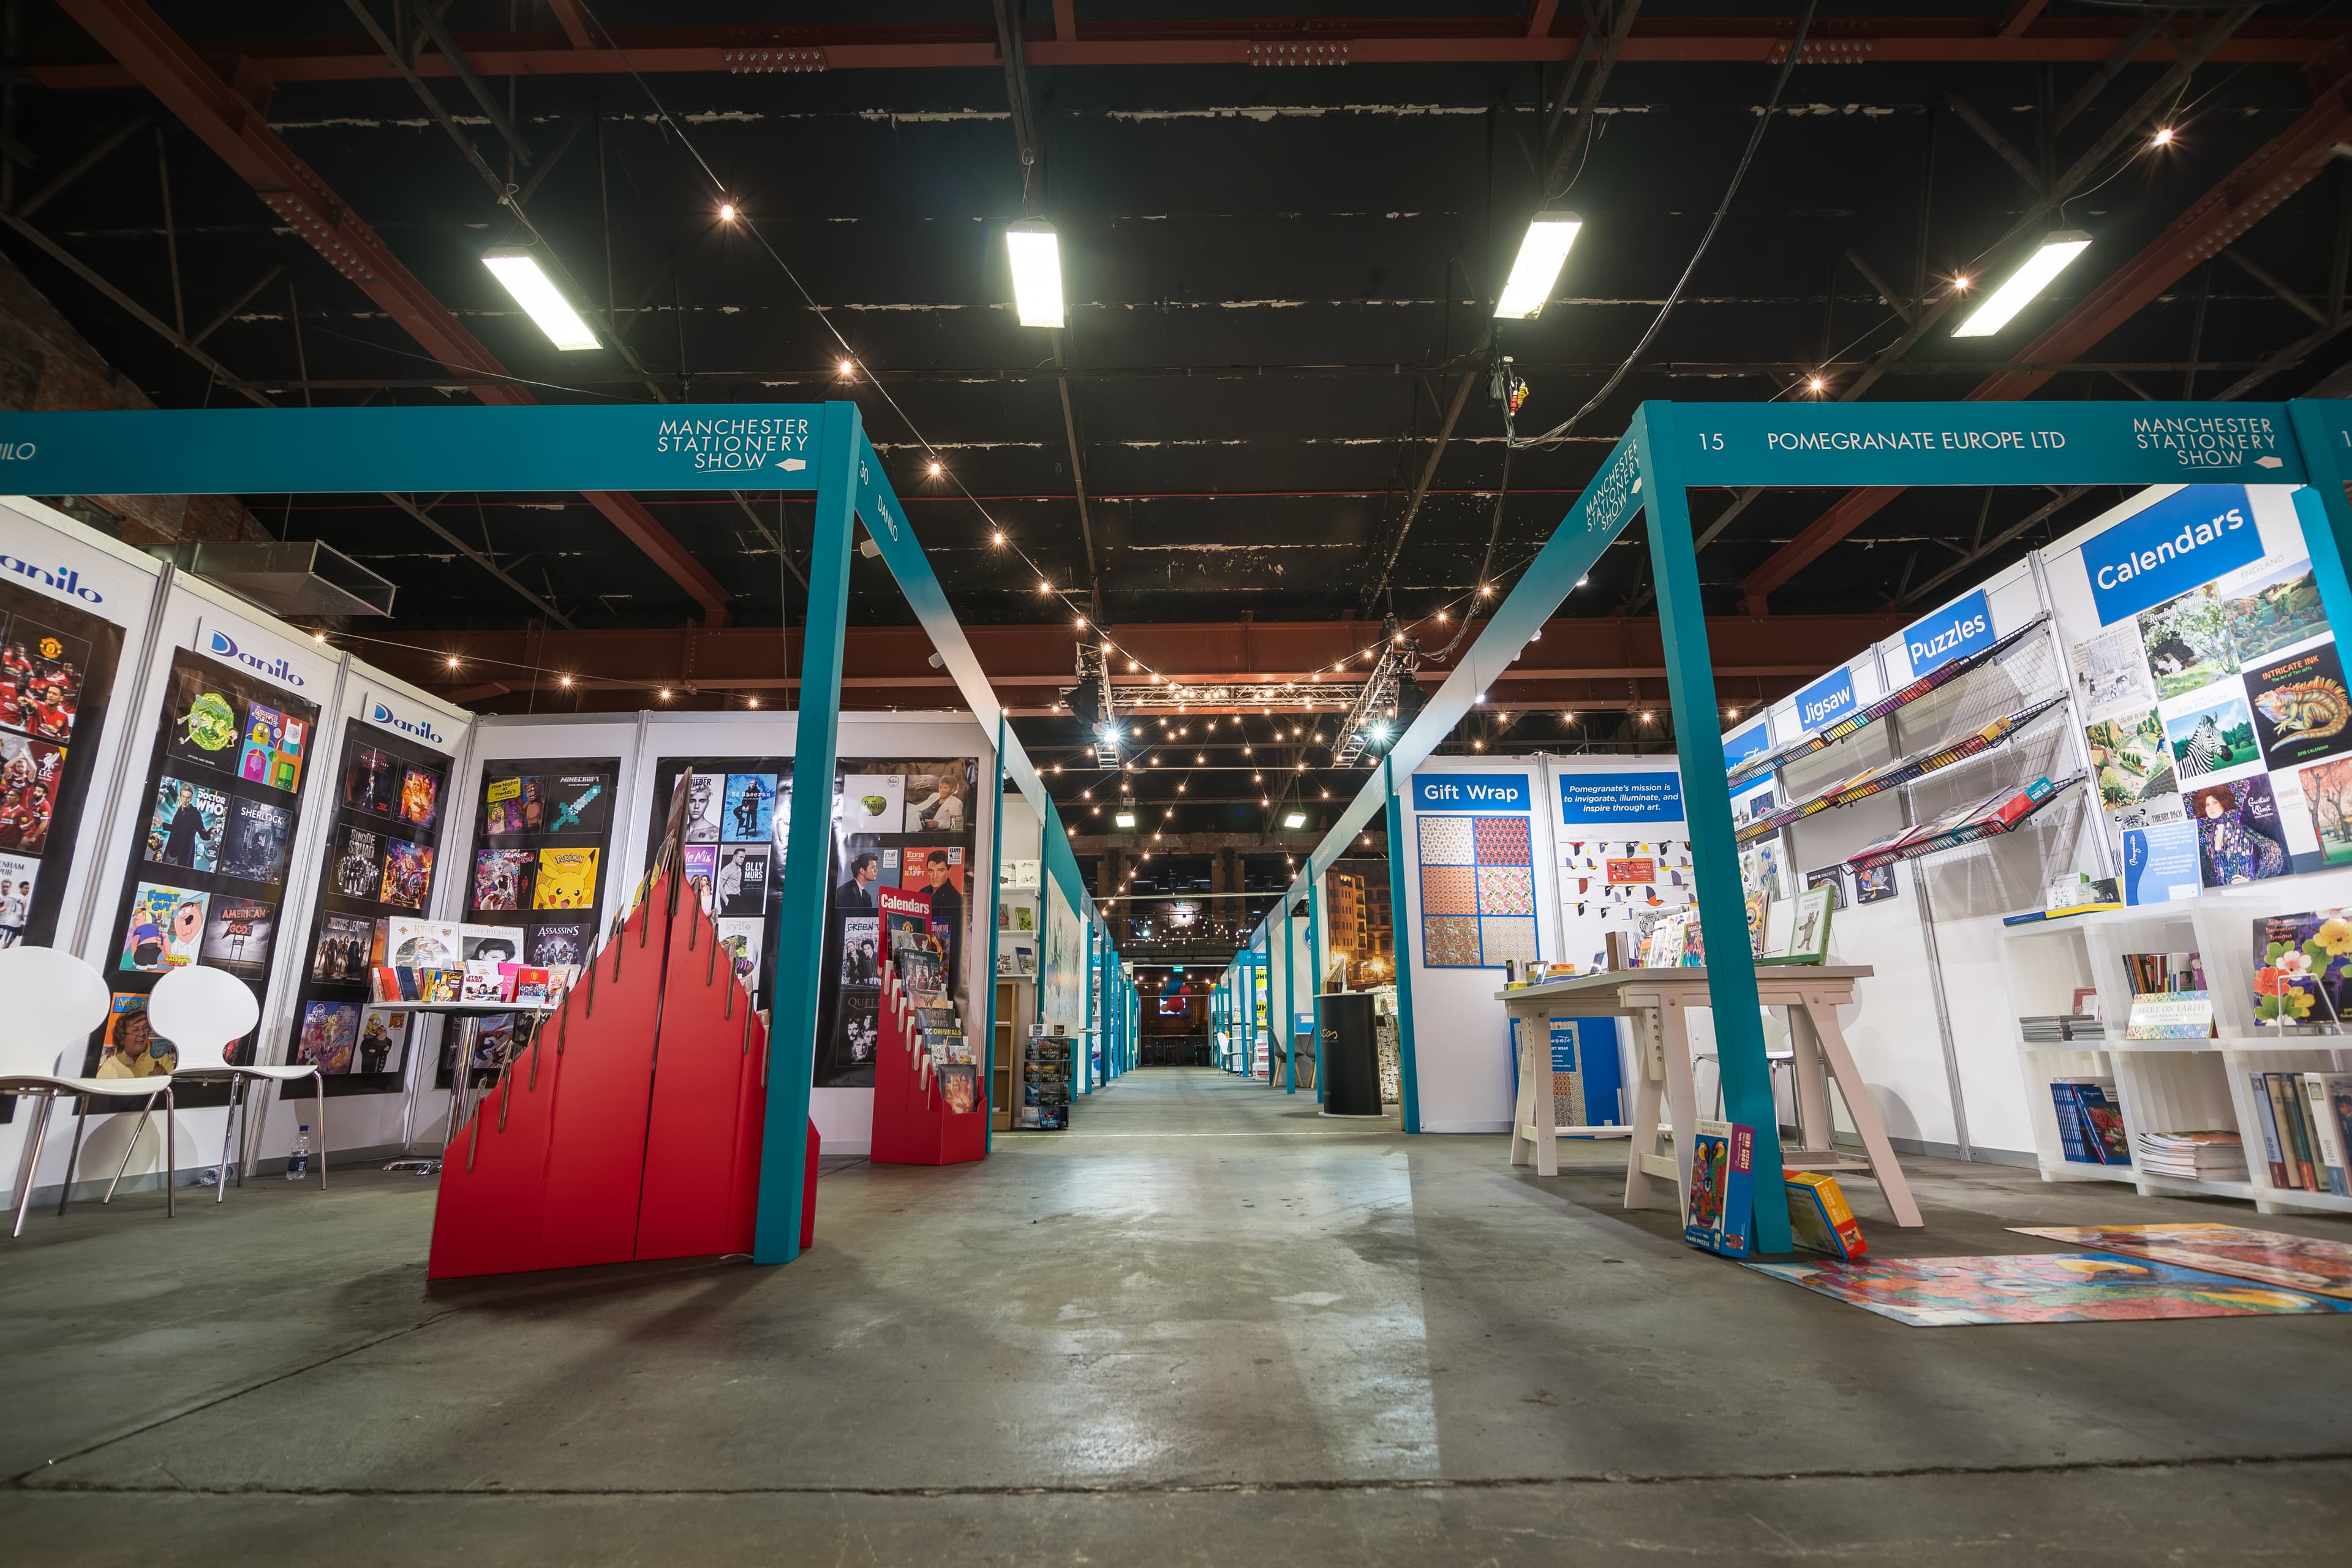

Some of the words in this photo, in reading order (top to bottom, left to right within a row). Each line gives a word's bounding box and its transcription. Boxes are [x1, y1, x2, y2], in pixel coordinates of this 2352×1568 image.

[658, 418, 809, 435] MANCHESTER
[2133, 418, 2274, 433] MANCHESTER
[657, 435, 809, 453] STATIONERY
[1698, 432, 1725, 451] 15
[1767, 432, 1936, 450] POMEGRANATE
[1940, 431, 2026, 450] EUROPE
[2030, 431, 2067, 449] LTD
[2136, 434, 2275, 450] STATIONERY
[0, 442, 37, 460] ILO
[2176, 450, 2243, 466] SHOW
[694, 452, 767, 469] SHOW
[859, 459, 869, 485] 30
[877, 494, 898, 542] DANILO
[1586, 456, 1640, 532] STATIONERY
[1601, 488, 1627, 531] SHOW
[2097, 508, 2245, 590] Calendars
[2240, 554, 2285, 579] ENGLAND
[0, 554, 103, 603] anilo
[1910, 614, 1986, 666] Puzzles
[207, 628, 304, 687] Danilo
[2261, 662, 2303, 680] INTRICATE
[2304, 655, 2320, 666] INK
[1803, 685, 1851, 725] Jigsaw
[371, 701, 443, 744] Danilo
[197, 790, 226, 805] DOCTOR
[495, 788, 516, 797] Freddy's
[1424, 784, 1460, 800] Gift
[1466, 785, 1518, 802] Wrap
[1569, 785, 1629, 794] Pomegranate's
[195, 799, 224, 816] WHO
[864, 801, 883, 809] BEATLES
[1613, 804, 1645, 812] through
[2247, 796, 2271, 807] Gustav
[2251, 805, 2272, 815] Klimt
[240, 806, 284, 825] SHERLOCK
[2150, 811, 2169, 823] THIERRY
[2169, 809, 2183, 820] BISCH
[350, 828, 376, 846] SUICIDE
[347, 839, 375, 859] SQUAD
[695, 850, 712, 863] Mix
[745, 861, 764, 872] OLLY
[147, 889, 181, 903] FAMILY
[880, 892, 930, 915] Calendars
[151, 901, 172, 912] GUY
[222, 907, 266, 919] AMERICAN
[228, 923, 253, 935] GODS
[328, 916, 349, 930] JUSTICE
[349, 919, 371, 934] LEAGUE
[486, 928, 518, 937] RICHARD
[537, 925, 579, 937] ASSASSIN'S
[725, 921, 752, 932] kylie
[847, 922, 873, 932] GREEN
[2177, 1003, 2205, 1012] EARTH
